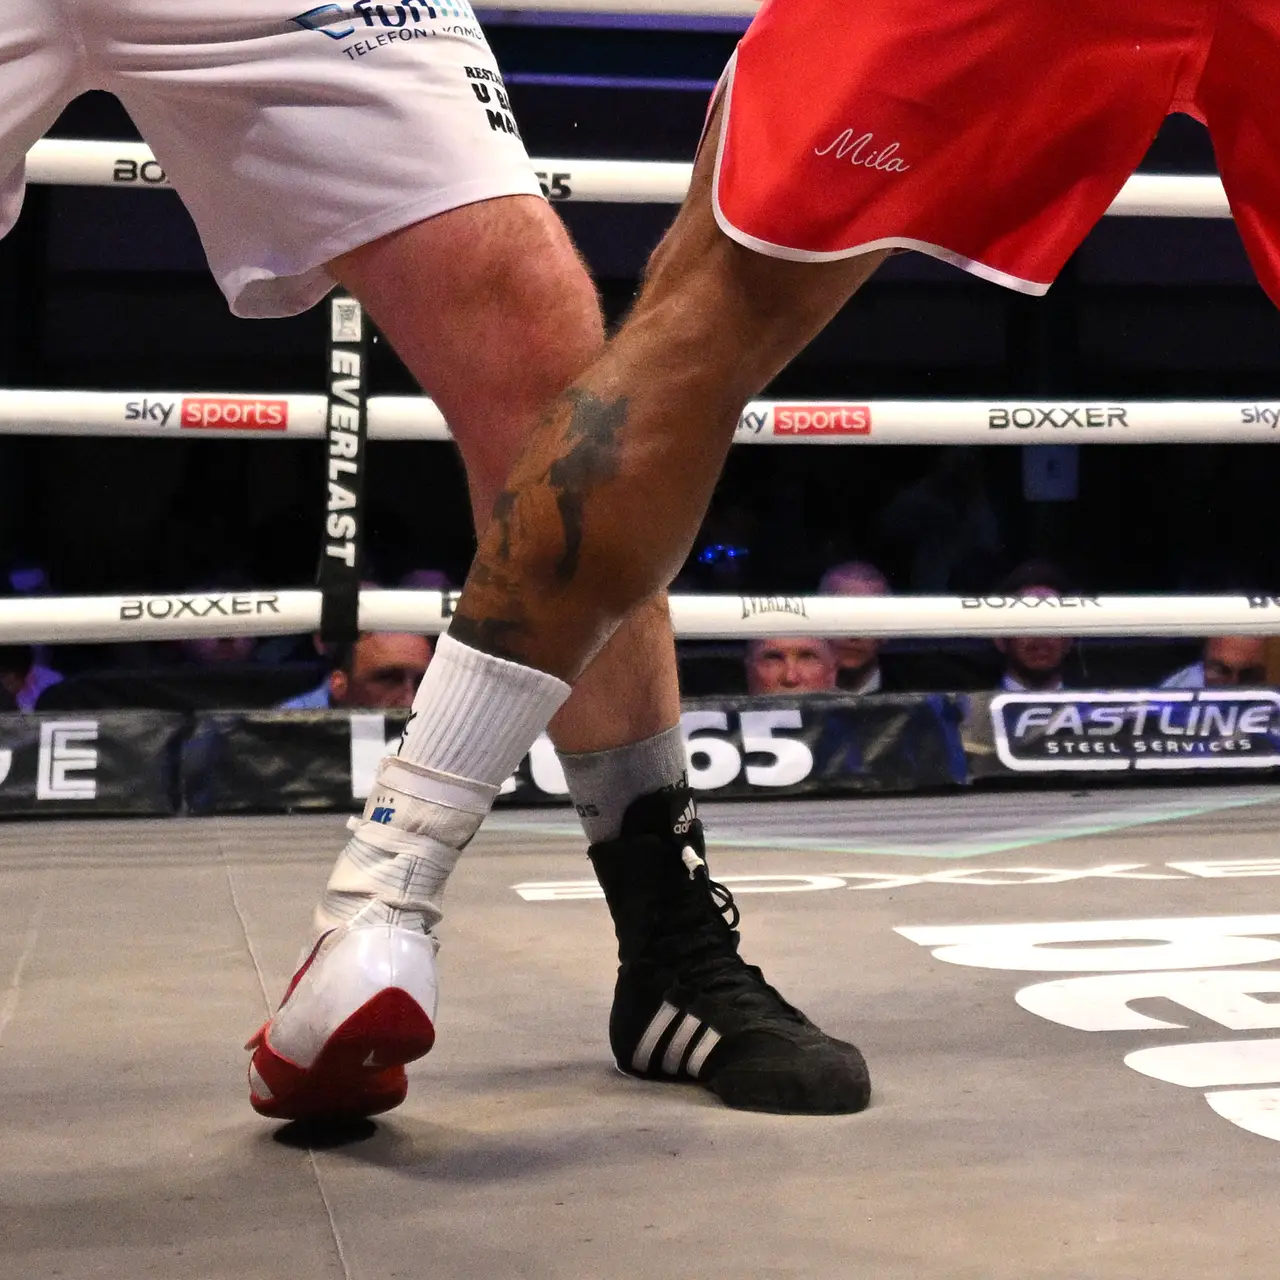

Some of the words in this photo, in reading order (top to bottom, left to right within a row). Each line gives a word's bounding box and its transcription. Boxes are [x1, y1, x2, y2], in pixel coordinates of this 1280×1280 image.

[814, 127, 911, 173] Mila
[125, 400, 174, 427] sky
[187, 401, 284, 428] sports
[779, 407, 870, 433] sports
[988, 407, 1129, 430] BOXXER
[325, 349, 361, 568] EVERLAST
[121, 593, 281, 622] BOXXER
[1015, 704, 1274, 738] FASTLINE
[1045, 740, 1120, 755] STEEL
[1134, 737, 1253, 754] SERVICES
